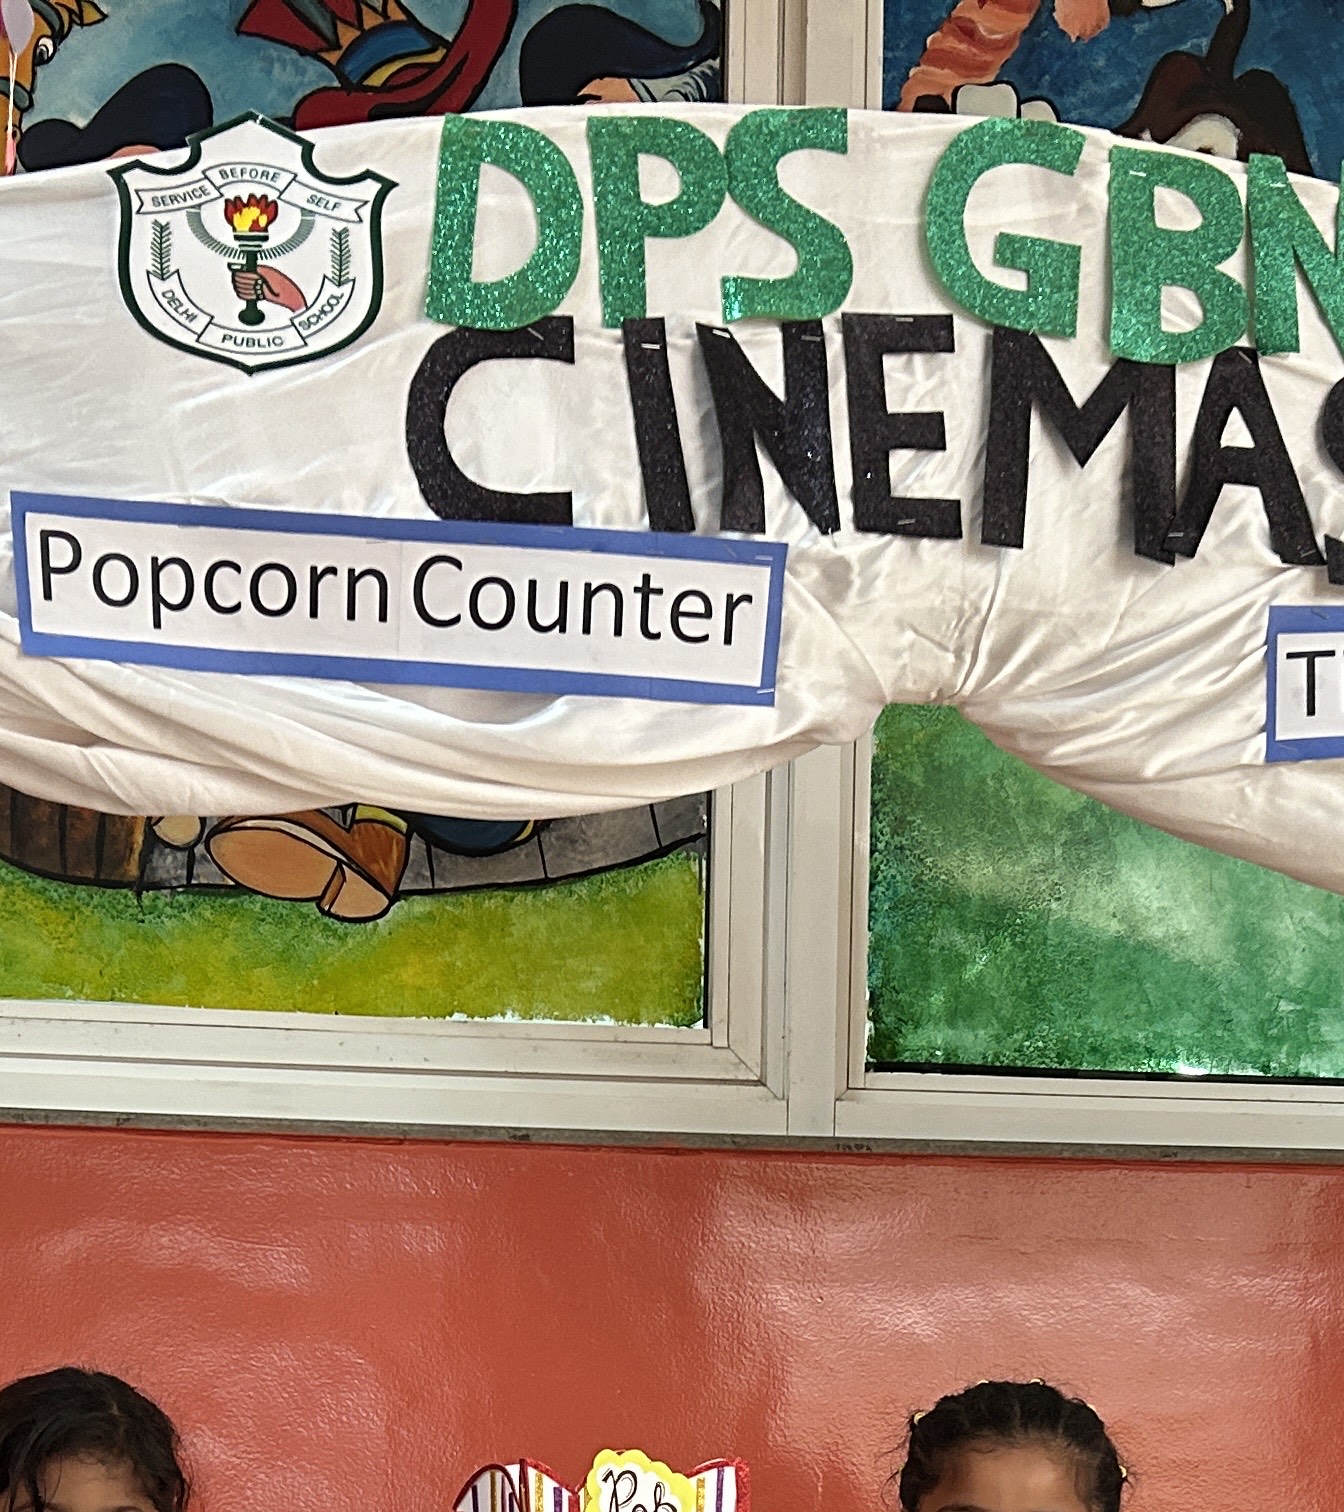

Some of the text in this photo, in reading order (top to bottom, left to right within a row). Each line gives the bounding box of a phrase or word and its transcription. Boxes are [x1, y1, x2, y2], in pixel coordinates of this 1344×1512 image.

[151, 169, 342, 211] SERVICE BEFORE SELF
[425, 107, 854, 330] DPS
[161, 290, 344, 348] DELHI PUBLIC SCHOOL
[38, 529, 752, 645] Popcorn Counter
